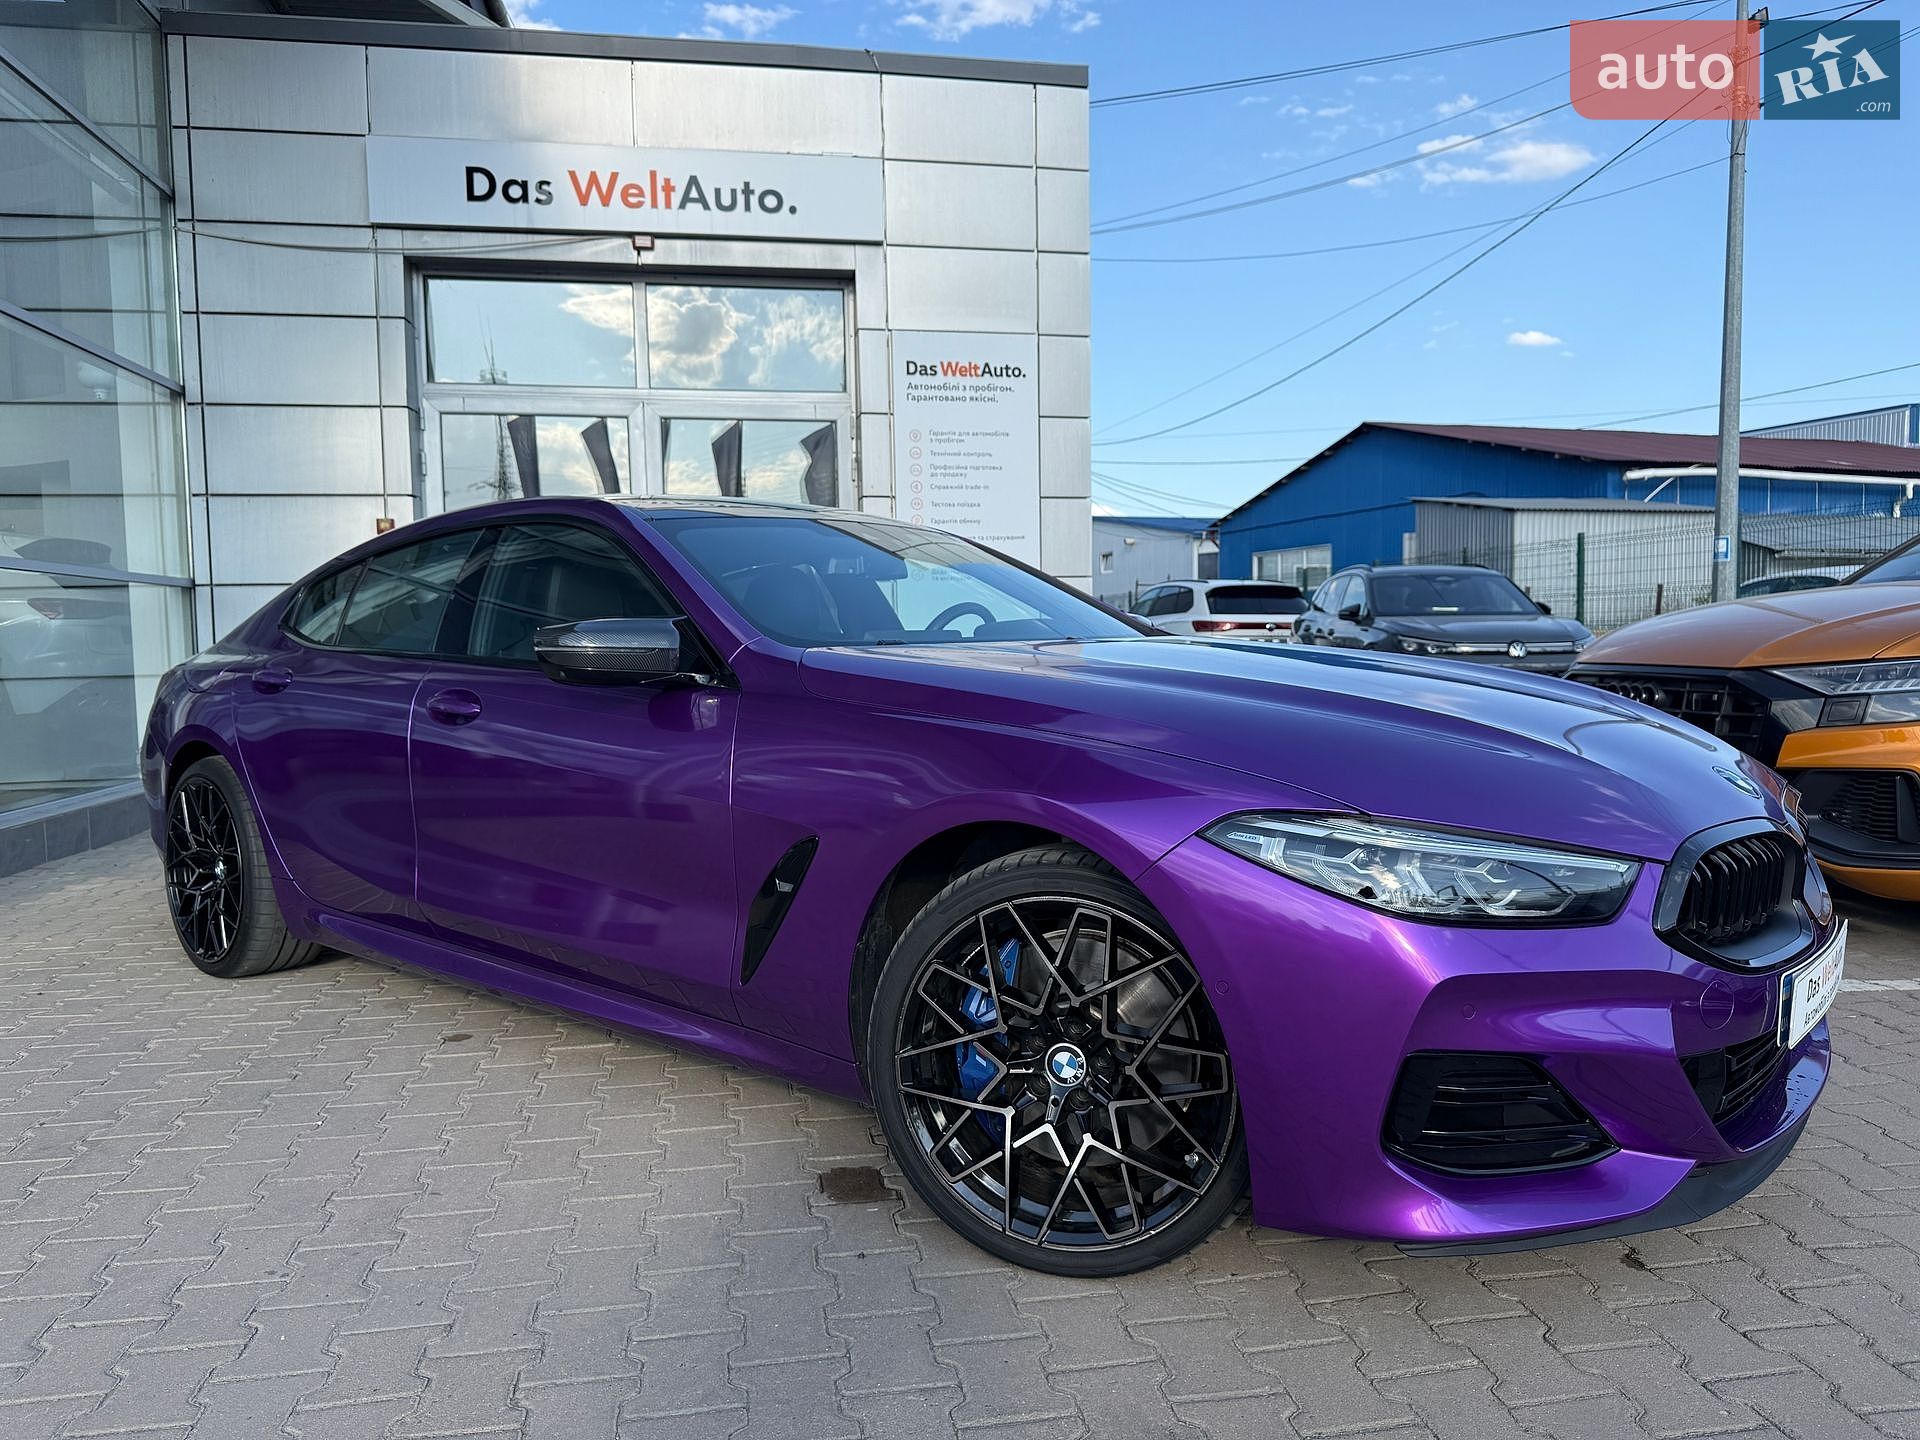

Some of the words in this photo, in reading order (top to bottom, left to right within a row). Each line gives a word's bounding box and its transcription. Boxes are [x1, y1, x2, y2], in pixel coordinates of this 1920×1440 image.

[465, 166, 553, 206] Das
[568, 169, 798, 216] WeltAuto.
[906, 360, 938, 376] Das
[940, 361, 1027, 378] WeltAuto.
[907, 382, 960, 391] Автомобілі
[969, 383, 1015, 393] пробігом.
[906, 393, 967, 403] Гарантовано
[1807, 975, 1821, 1004] Das
